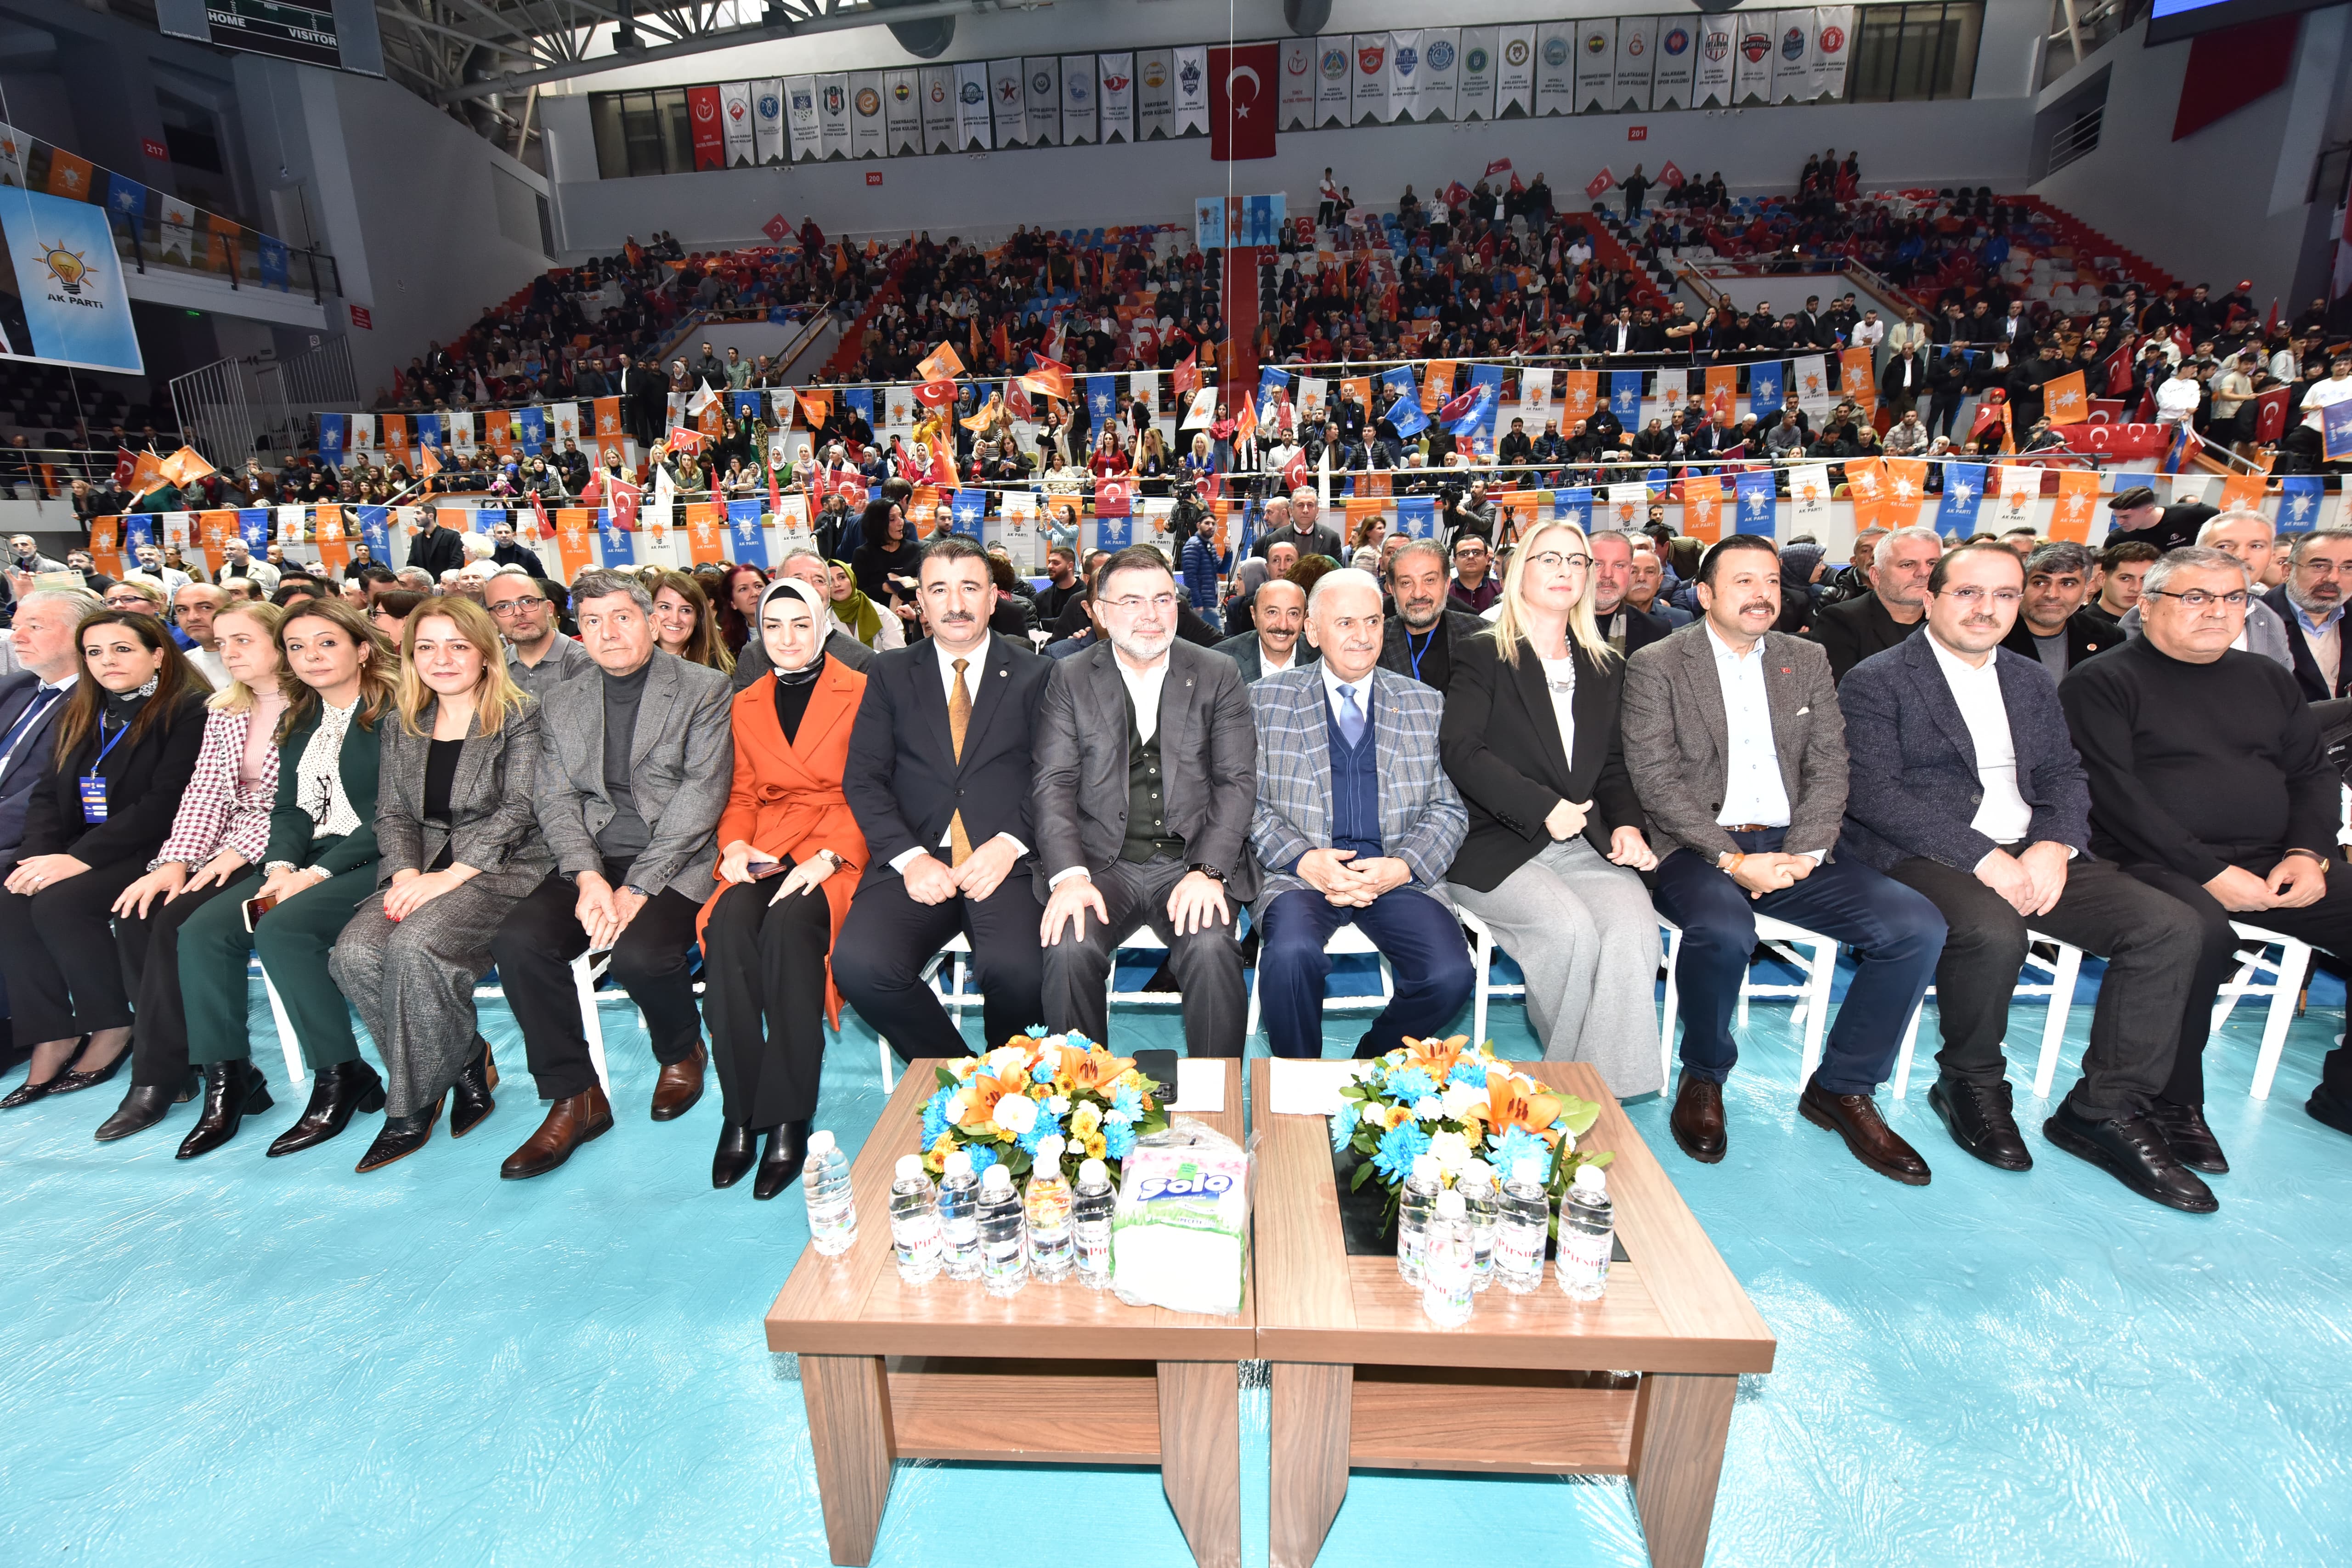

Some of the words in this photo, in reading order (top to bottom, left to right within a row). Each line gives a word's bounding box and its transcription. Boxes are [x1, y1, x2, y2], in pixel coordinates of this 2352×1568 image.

[208, 11, 247, 28] HOME
[288, 28, 338, 47] VISITOR
[146, 143, 164, 157] 217
[47, 293, 66, 303] AK
[1136, 1172, 1233, 1201] Solo
[1563, 1245, 1599, 1267] Pirsu
